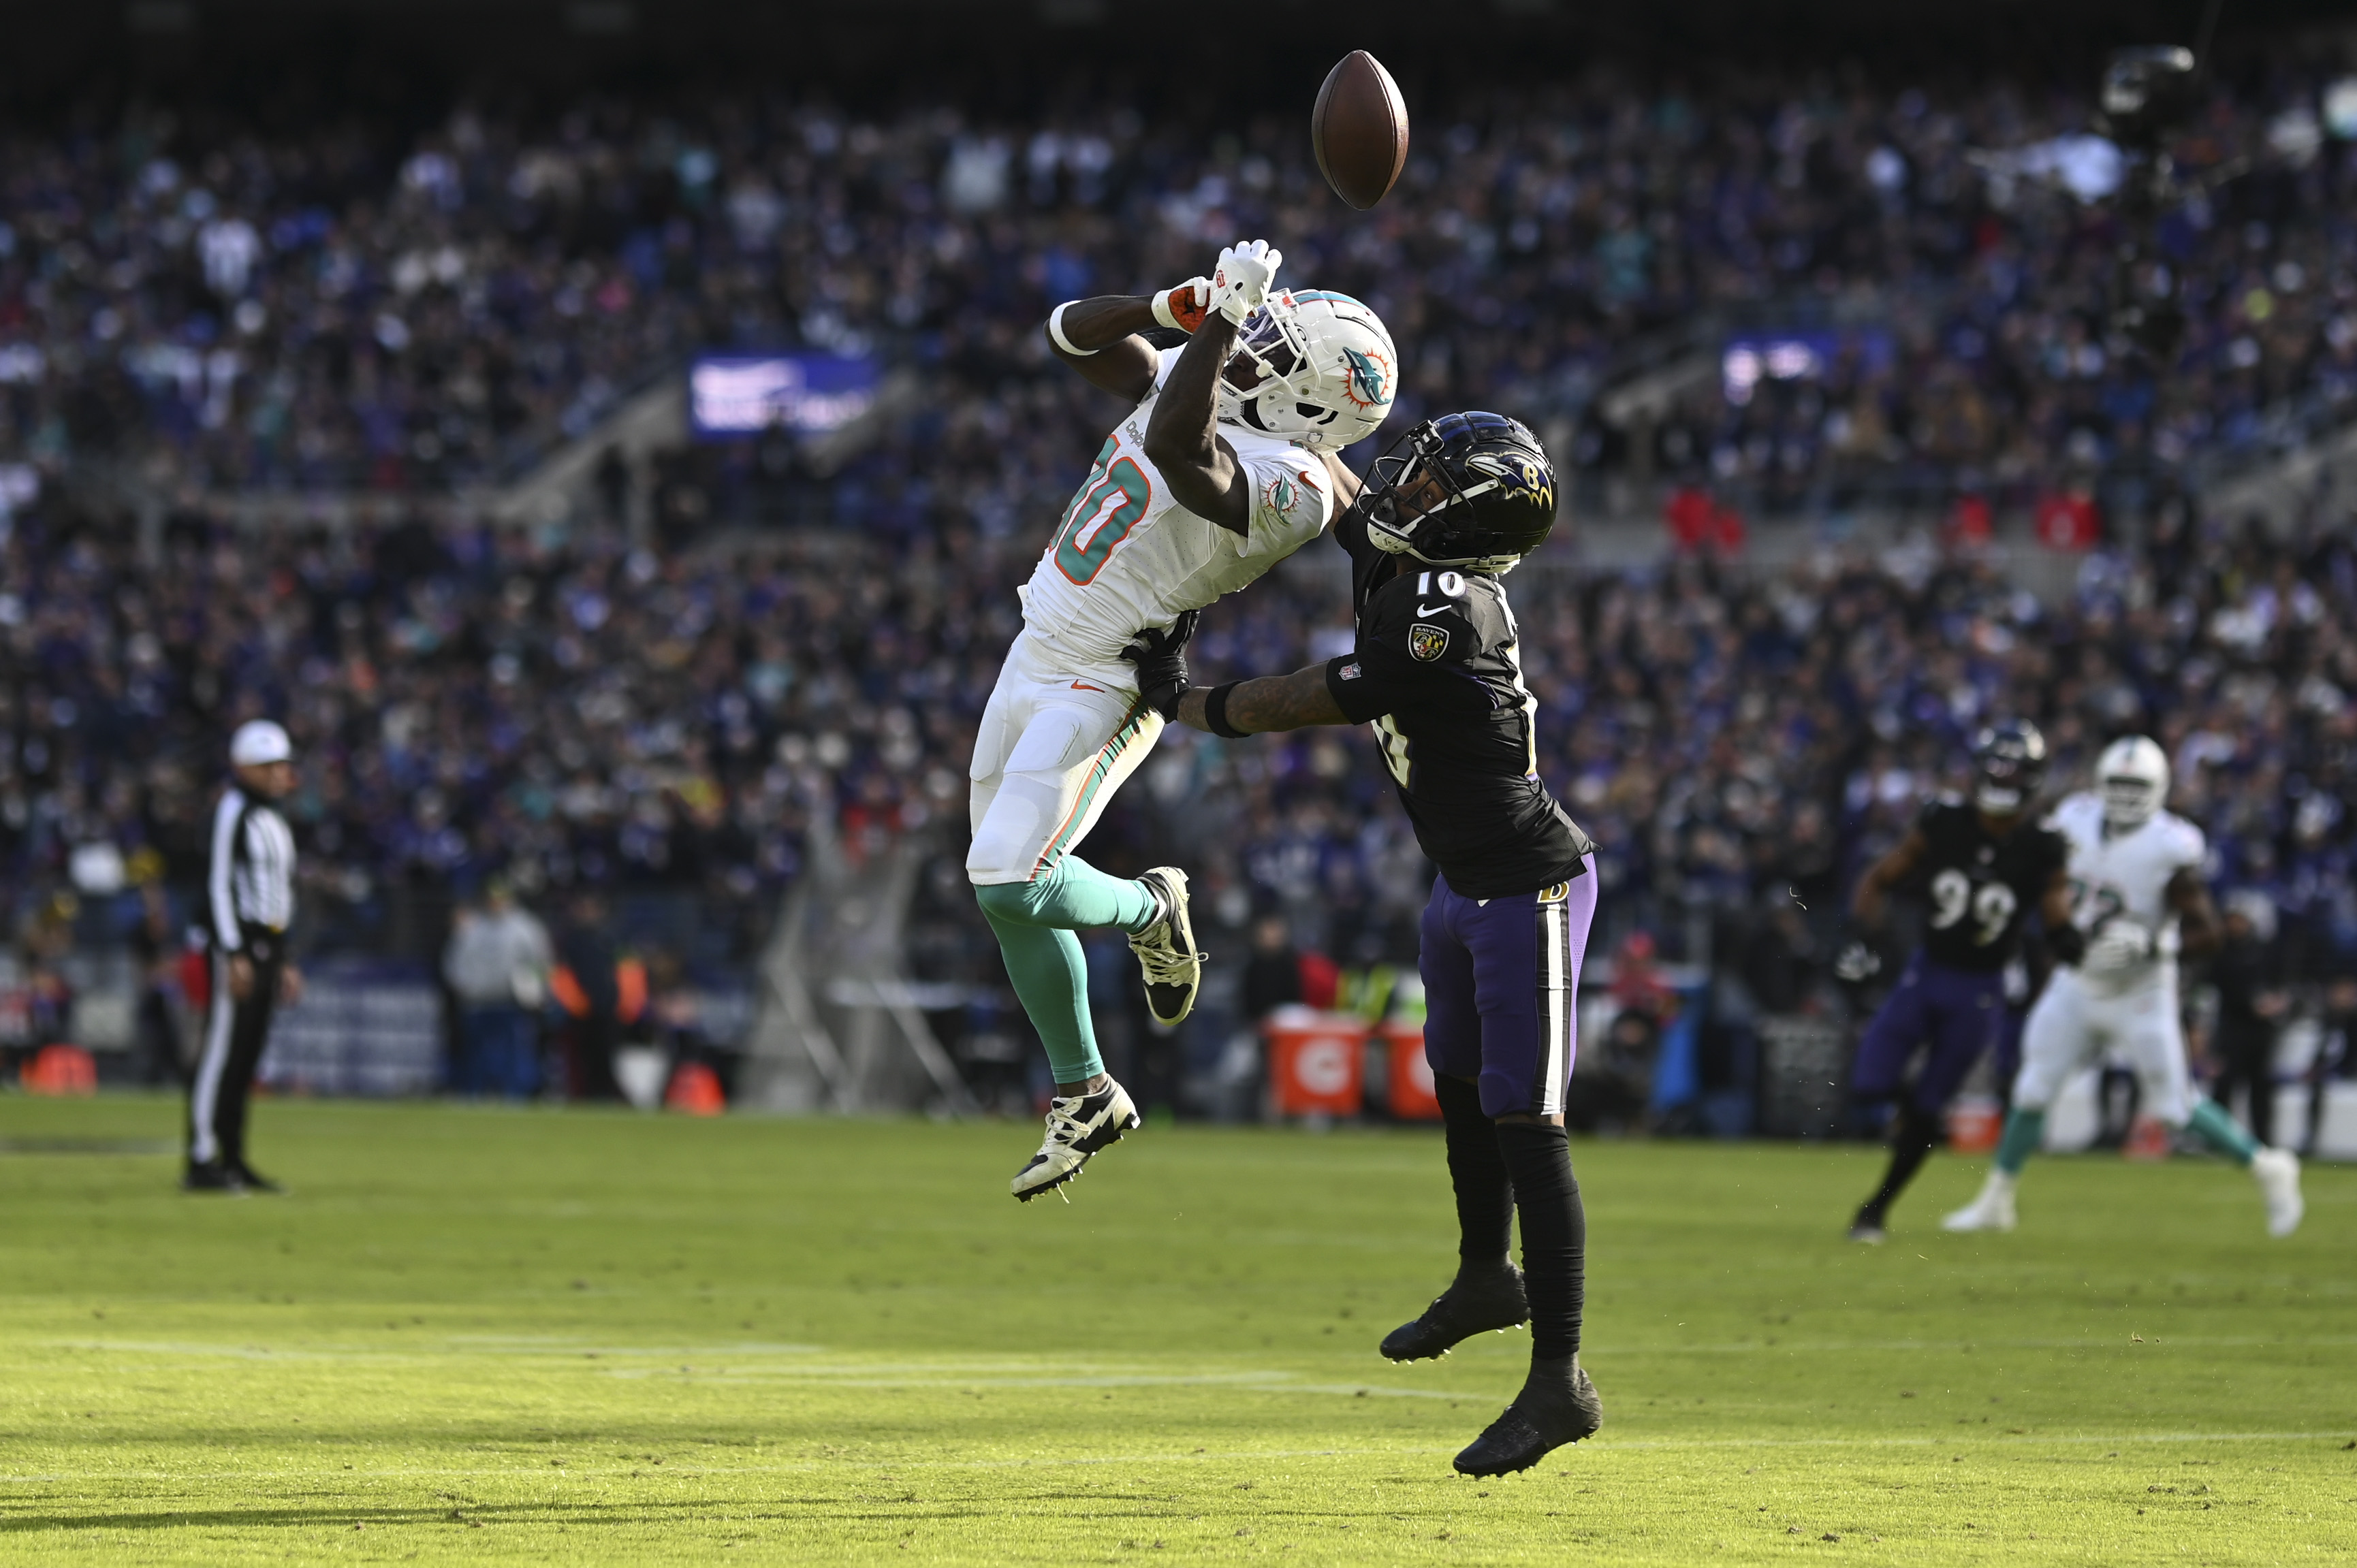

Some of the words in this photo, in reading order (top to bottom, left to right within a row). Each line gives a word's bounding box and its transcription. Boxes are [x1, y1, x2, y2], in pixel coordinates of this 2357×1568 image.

[1523, 464, 1539, 490] B
[1417, 571, 1466, 598] 10
[1417, 627, 1444, 637] RAVENS
[1930, 868, 2017, 946] 99
